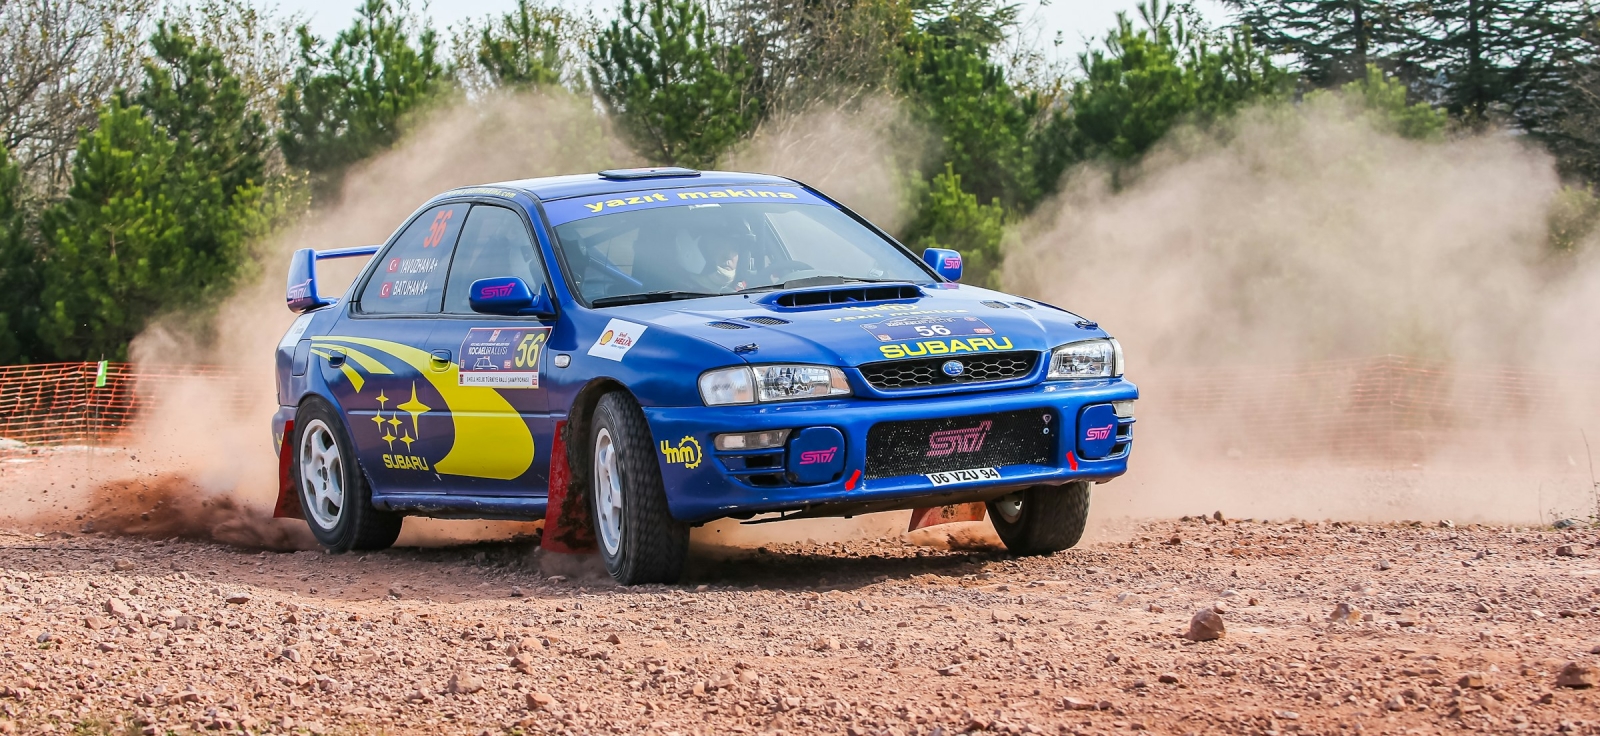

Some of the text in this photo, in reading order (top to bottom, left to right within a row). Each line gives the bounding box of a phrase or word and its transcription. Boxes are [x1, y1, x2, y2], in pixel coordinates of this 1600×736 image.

[677, 189, 798, 199] makina
[423, 209, 454, 248] 56
[392, 280, 421, 296] BATUHAN
[914, 325, 951, 336] 56
[515, 333, 545, 368] 56
[879, 336, 1014, 359] SUBARU
[382, 453, 430, 471] SUBARU
[931, 469, 998, 484] 06 VZU 94
